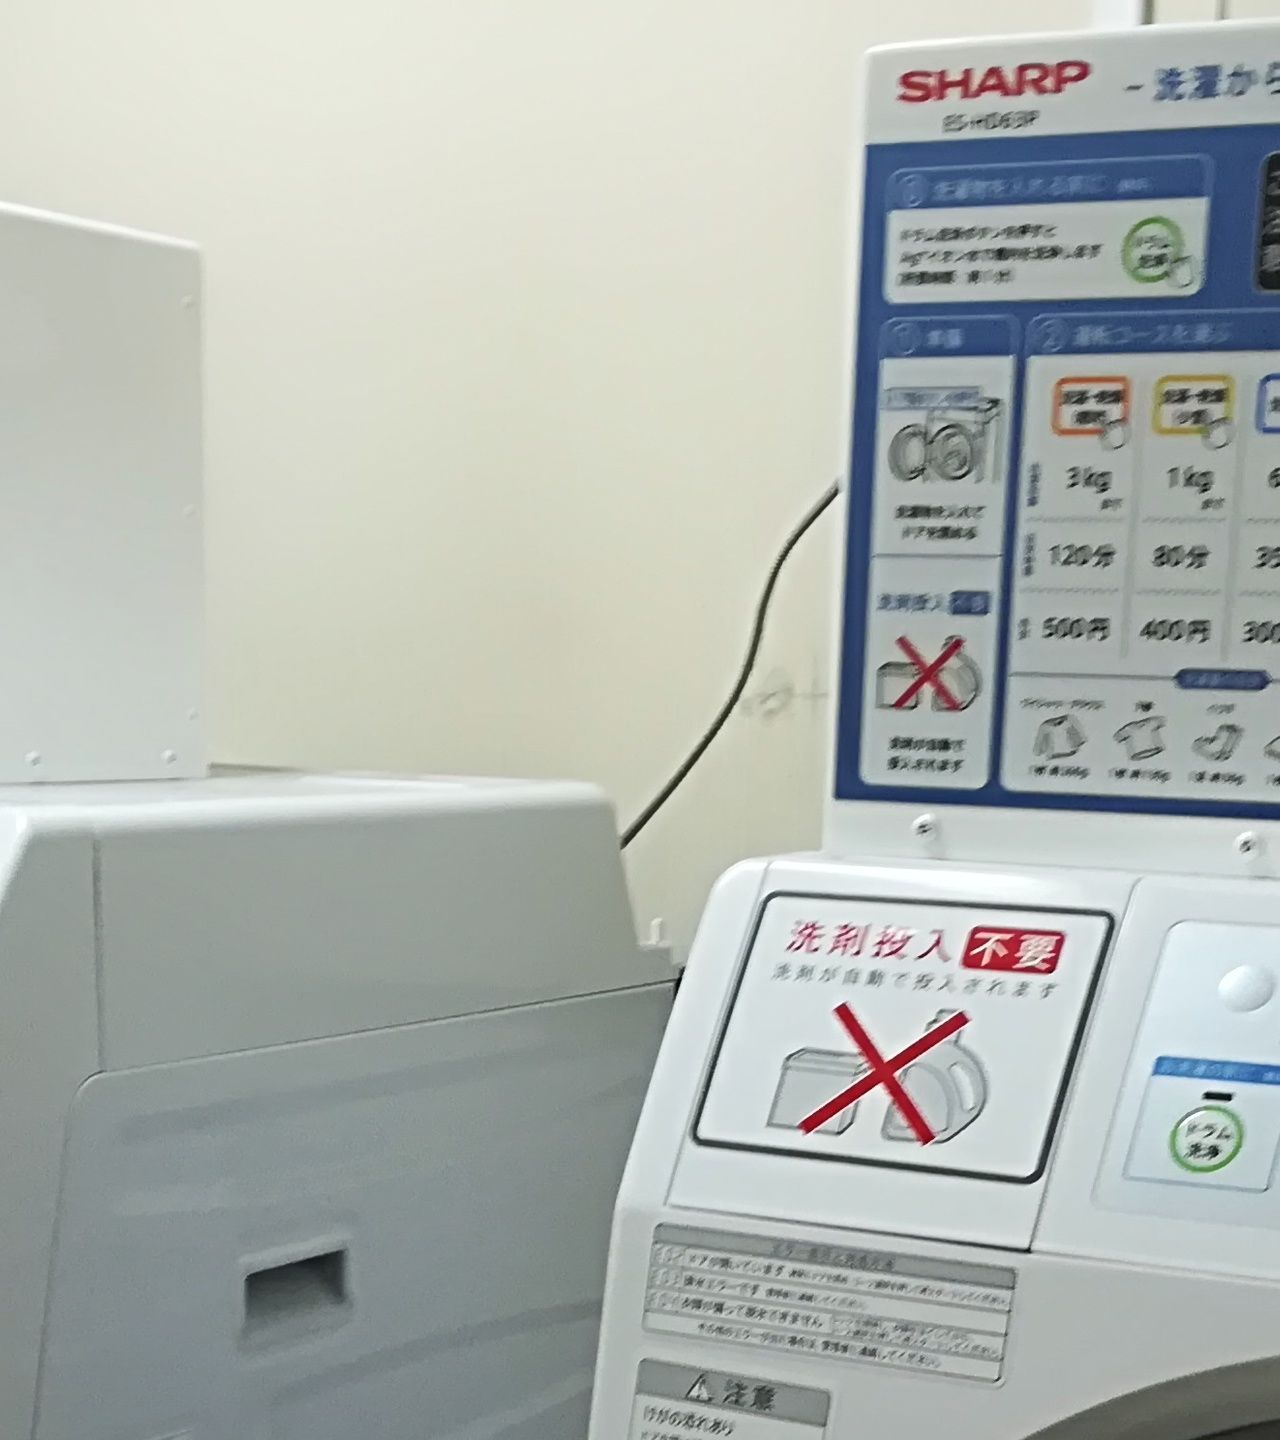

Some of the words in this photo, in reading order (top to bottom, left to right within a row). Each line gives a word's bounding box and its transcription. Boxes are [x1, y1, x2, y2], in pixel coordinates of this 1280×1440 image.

[897, 60, 1092, 103] SHARP
[784, 917, 952, 964] 洗剤投入
[968, 931, 1064, 971] 不要
[772, 961, 1061, 999] 洗剤が自動で投入されます
